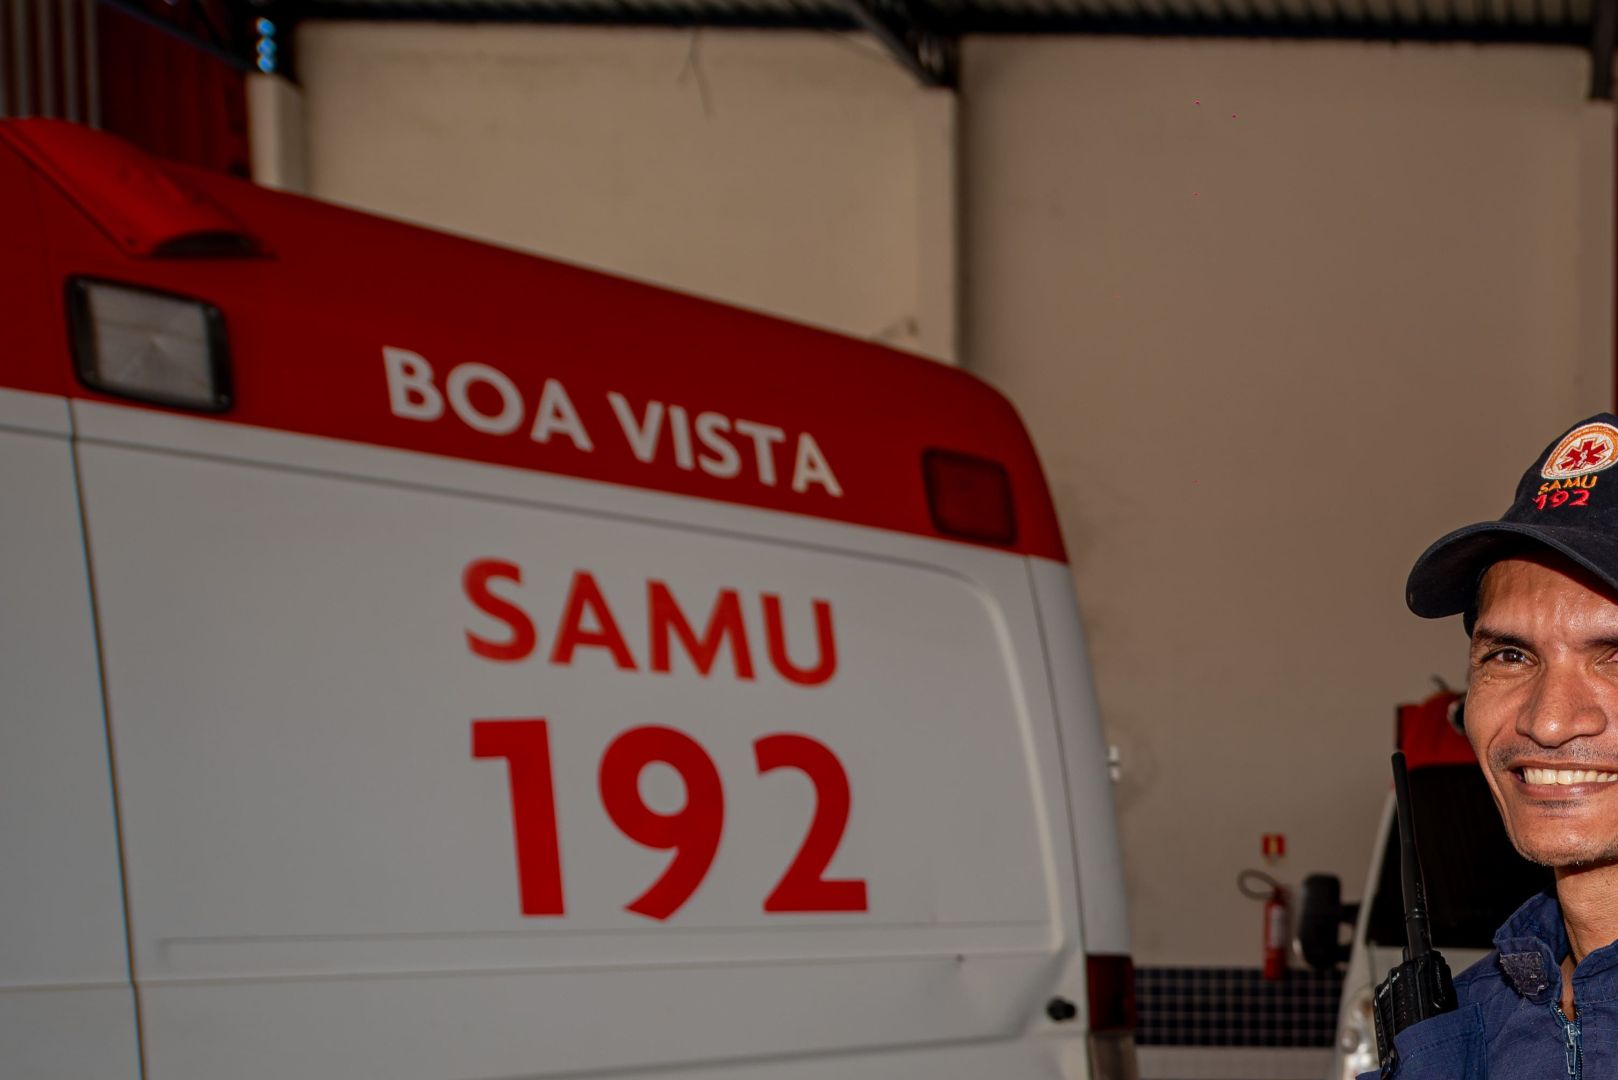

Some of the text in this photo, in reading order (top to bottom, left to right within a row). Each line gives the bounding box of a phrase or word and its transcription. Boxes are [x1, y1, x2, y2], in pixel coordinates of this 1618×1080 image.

[382, 345, 843, 497] BOA VISTA
[1538, 475, 1598, 495] SAMU
[1532, 489, 1590, 510] 192
[462, 556, 840, 687] SAMU
[470, 717, 869, 923] 192
